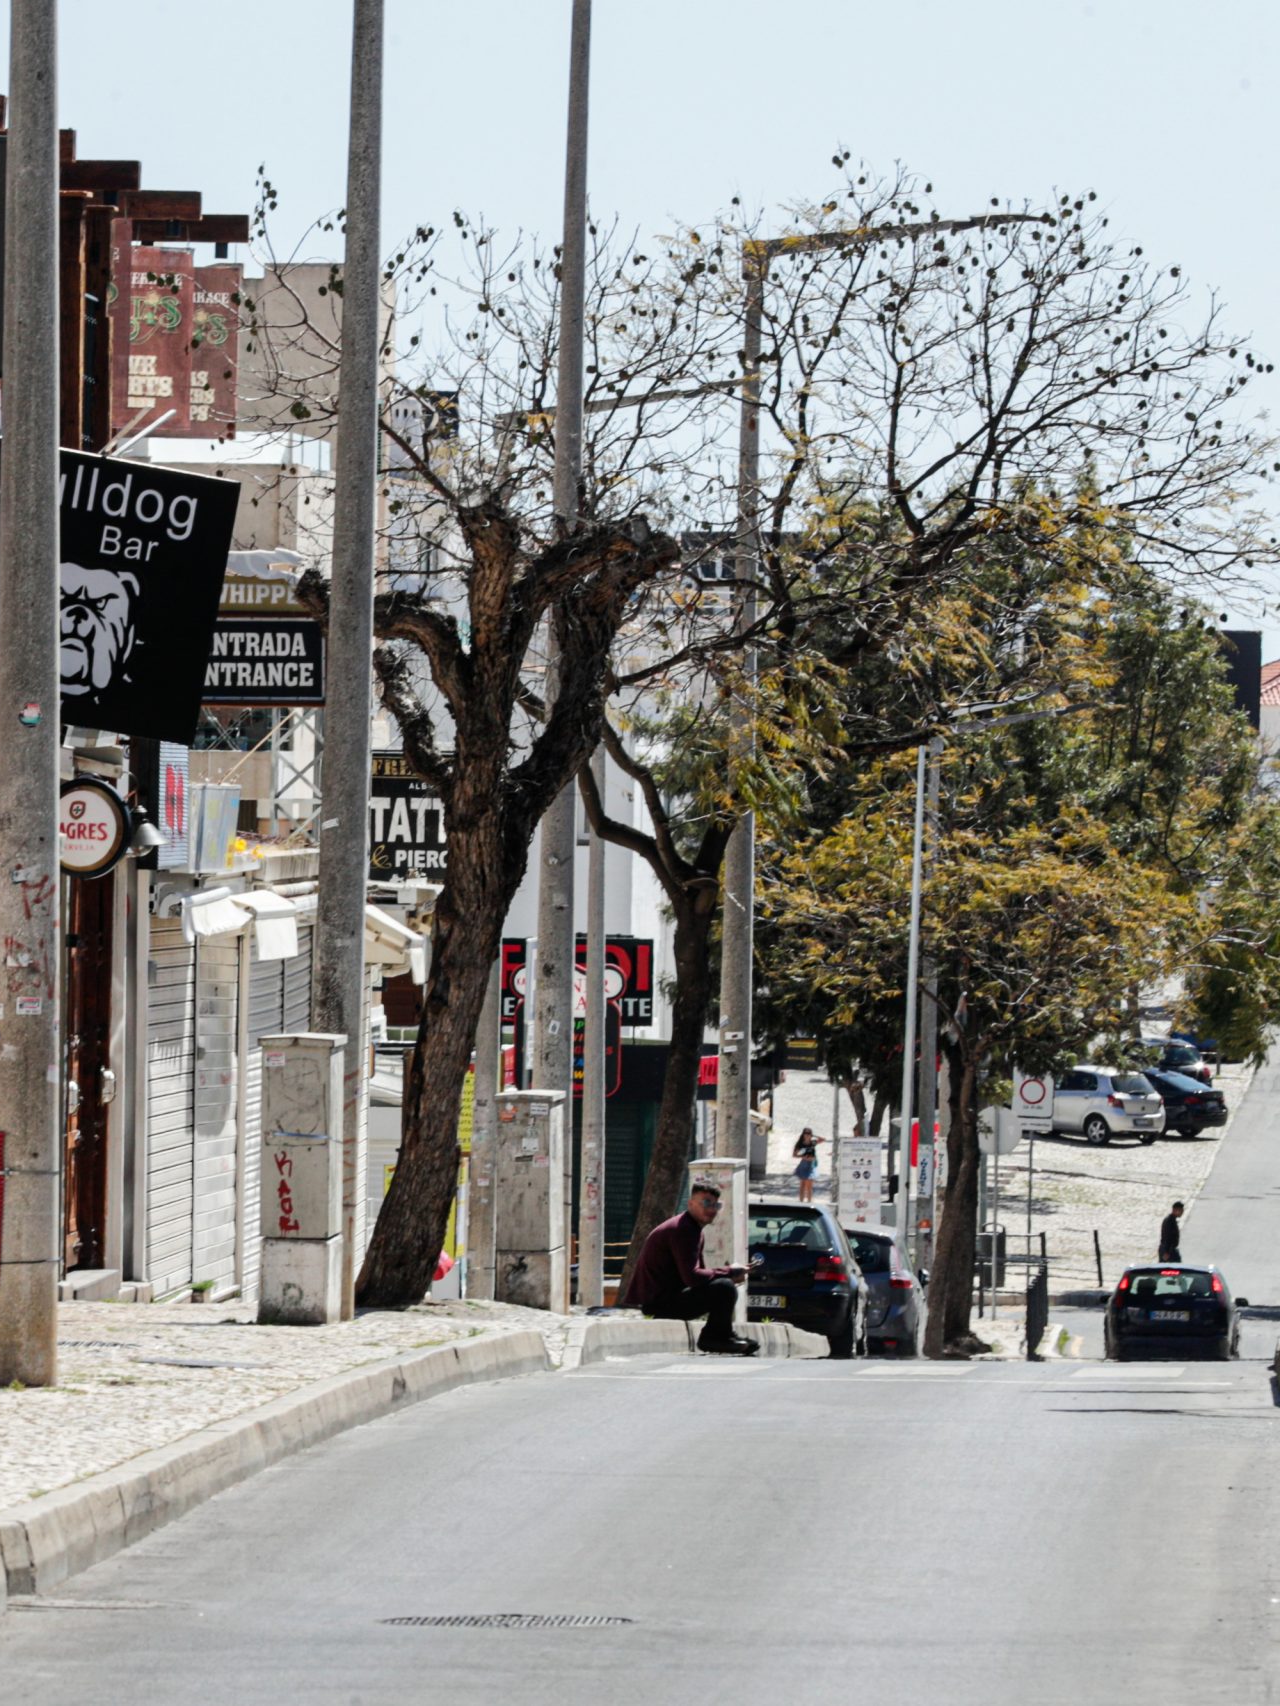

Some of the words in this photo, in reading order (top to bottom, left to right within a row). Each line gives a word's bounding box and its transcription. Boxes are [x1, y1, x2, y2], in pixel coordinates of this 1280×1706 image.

[99, 525, 159, 562] Bar
[212, 632, 306, 657] NTRADA
[204, 662, 314, 687] NTRANCE
[60, 822, 108, 841] AGRES
